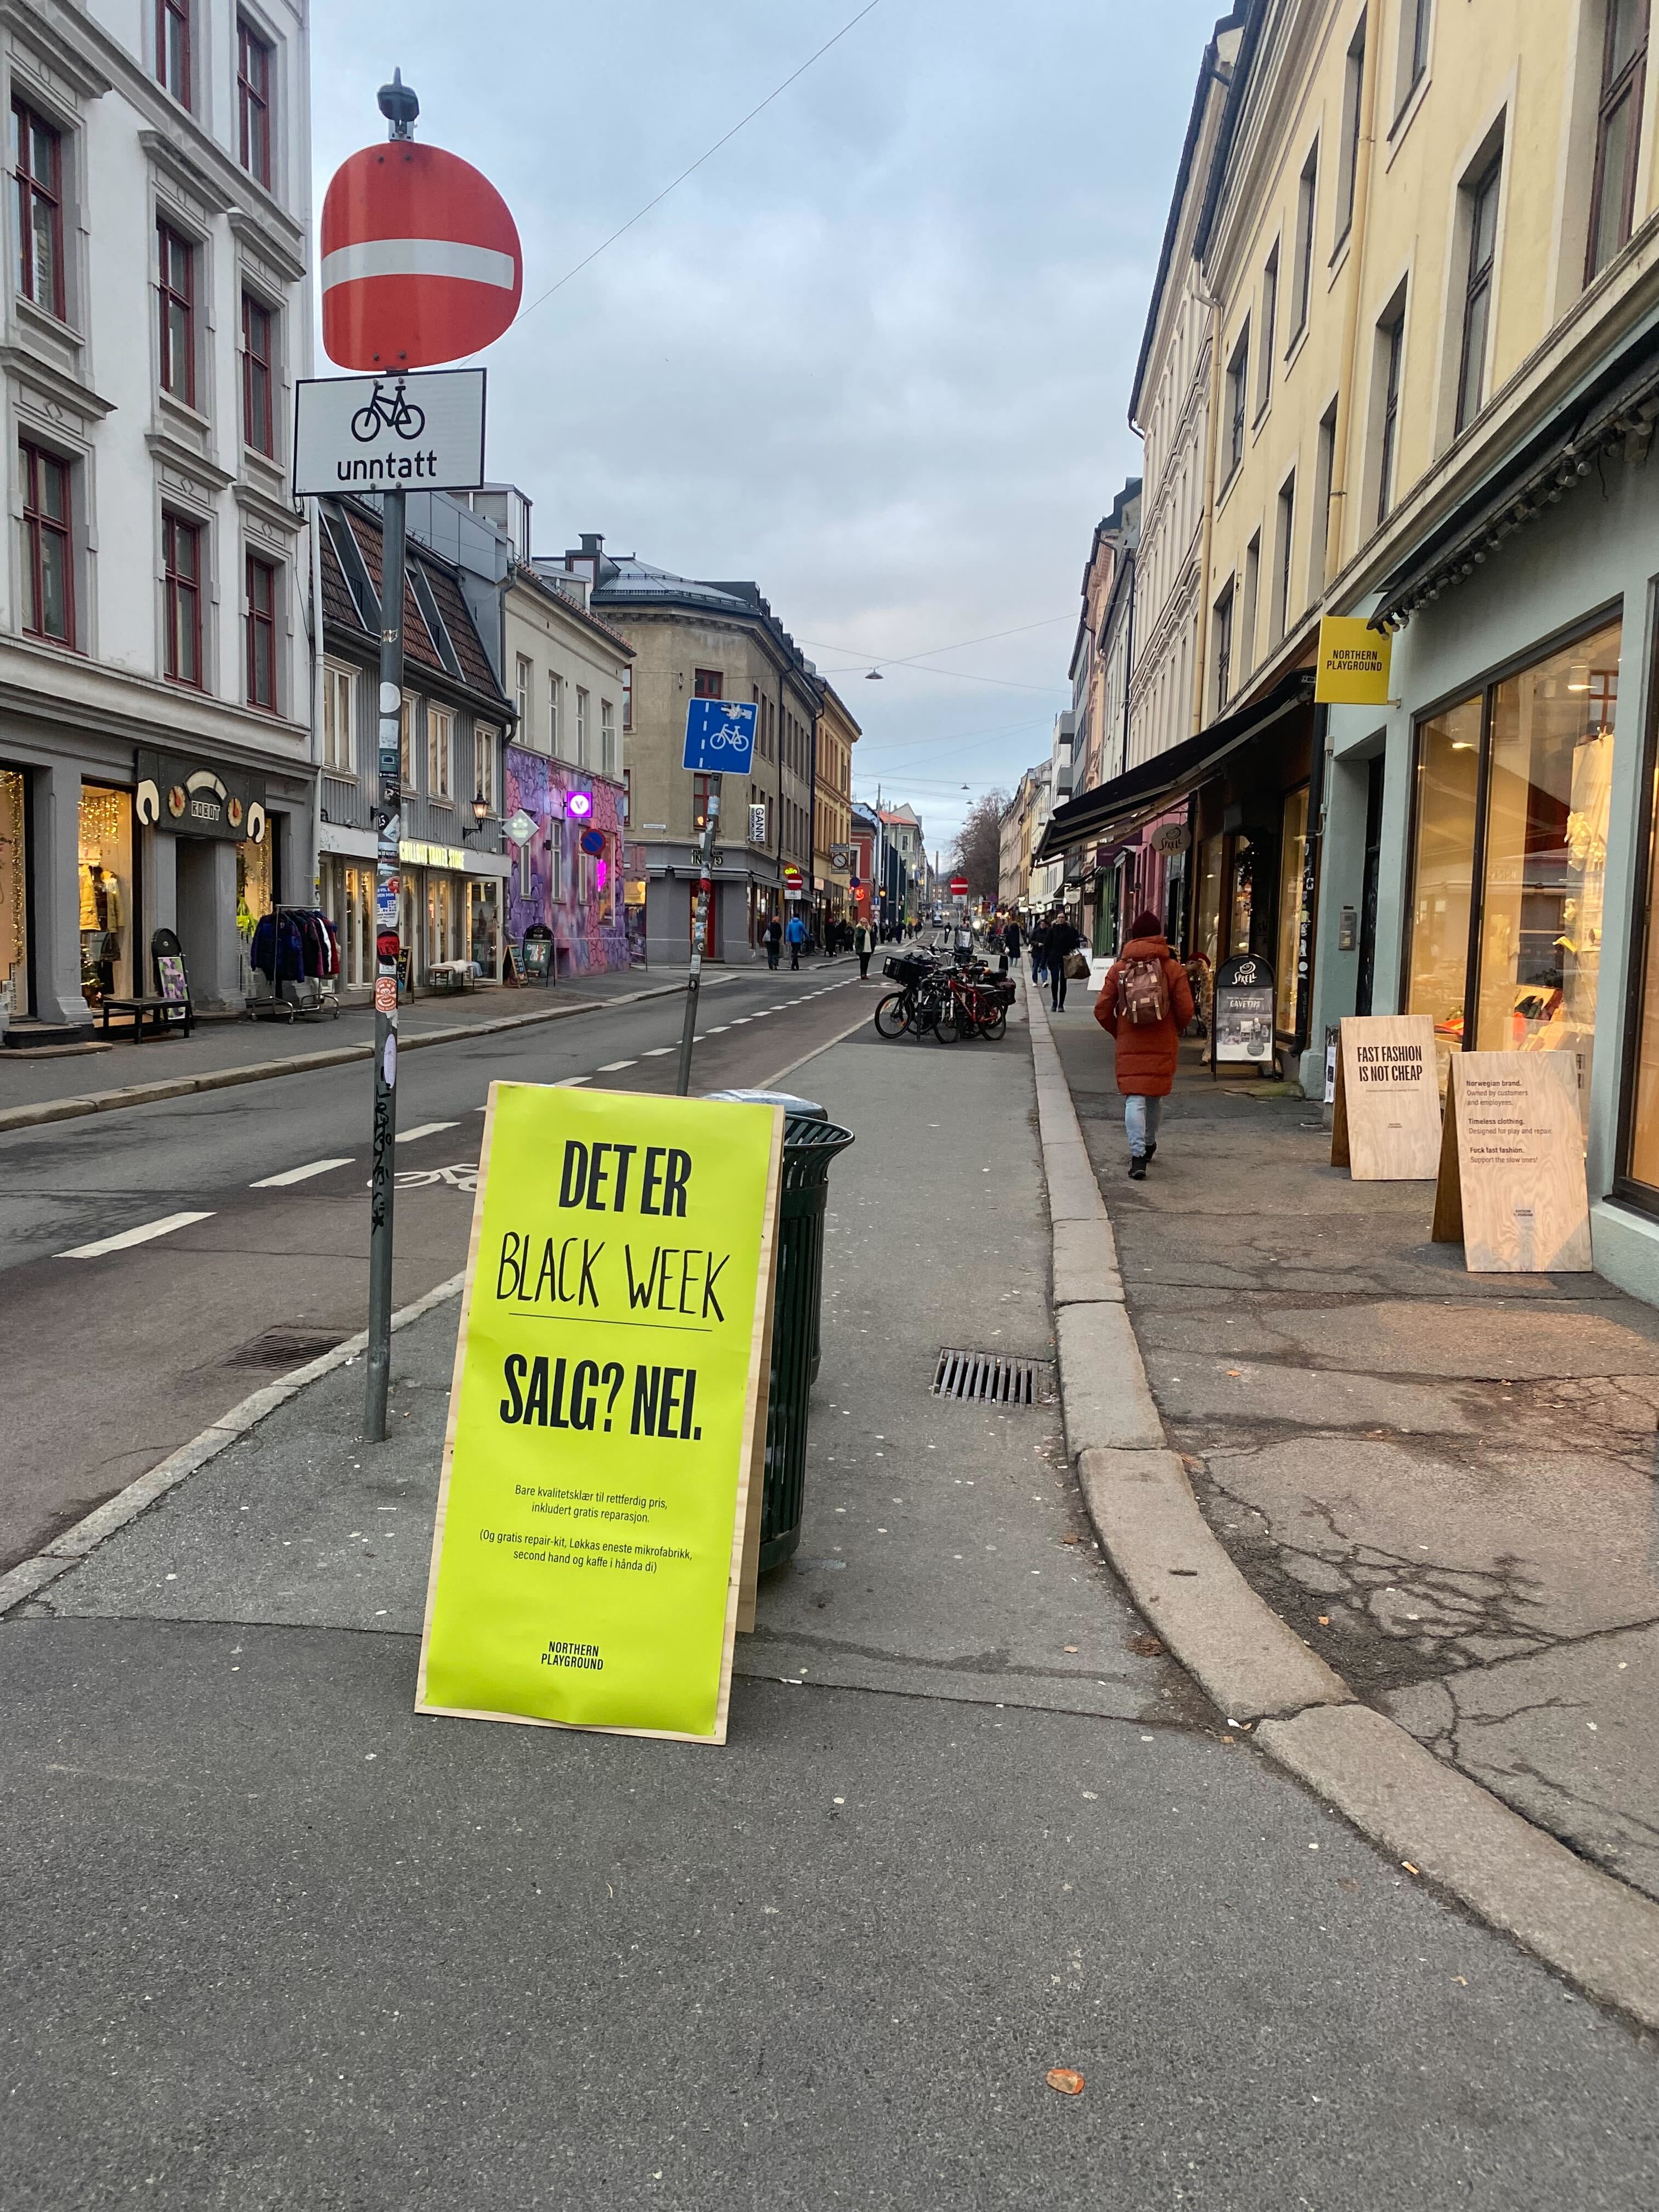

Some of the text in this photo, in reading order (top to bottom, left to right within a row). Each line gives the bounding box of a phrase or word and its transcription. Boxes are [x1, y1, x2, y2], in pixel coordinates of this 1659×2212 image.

[337, 449, 438, 481] unntatt
[1327, 660, 1383, 671] PLAYGROUND
[1333, 650, 1378, 660] NORTHERN
[191, 800, 221, 821] ROBOT
[755, 808, 764, 840] GANNI
[1158, 838, 1182, 851] SPRELL
[428, 845, 449, 867] TRAVEL
[448, 848, 465, 870] STORE
[1232, 971, 1257, 985] SPRELL
[1229, 1000, 1261, 1008] GAVETIPS
[1357, 1046, 1422, 1062] FAST FASHION
[1359, 1065, 1423, 1081] IS NOT CHEAP
[558, 1139, 692, 1218] DET ER
[496, 1231, 730, 1323] BLACK WEEK
[499, 1353, 702, 1441] SALG? NEI.
[515, 1484, 668, 1510] Bare kvalitetsklær til rettferdig pris,
[532, 1501, 650, 1524] inkludert gratis reparasjon.
[479, 1528, 692, 1561] (Og gratis repair-kit, Løkkas eneste mikrofabrikk,
[513, 1550, 657, 1574] second hand og kaffe i hånda di)
[548, 1641, 599, 1657] NORTHERN
[541, 1653, 603, 1670] PLAYGROUND
